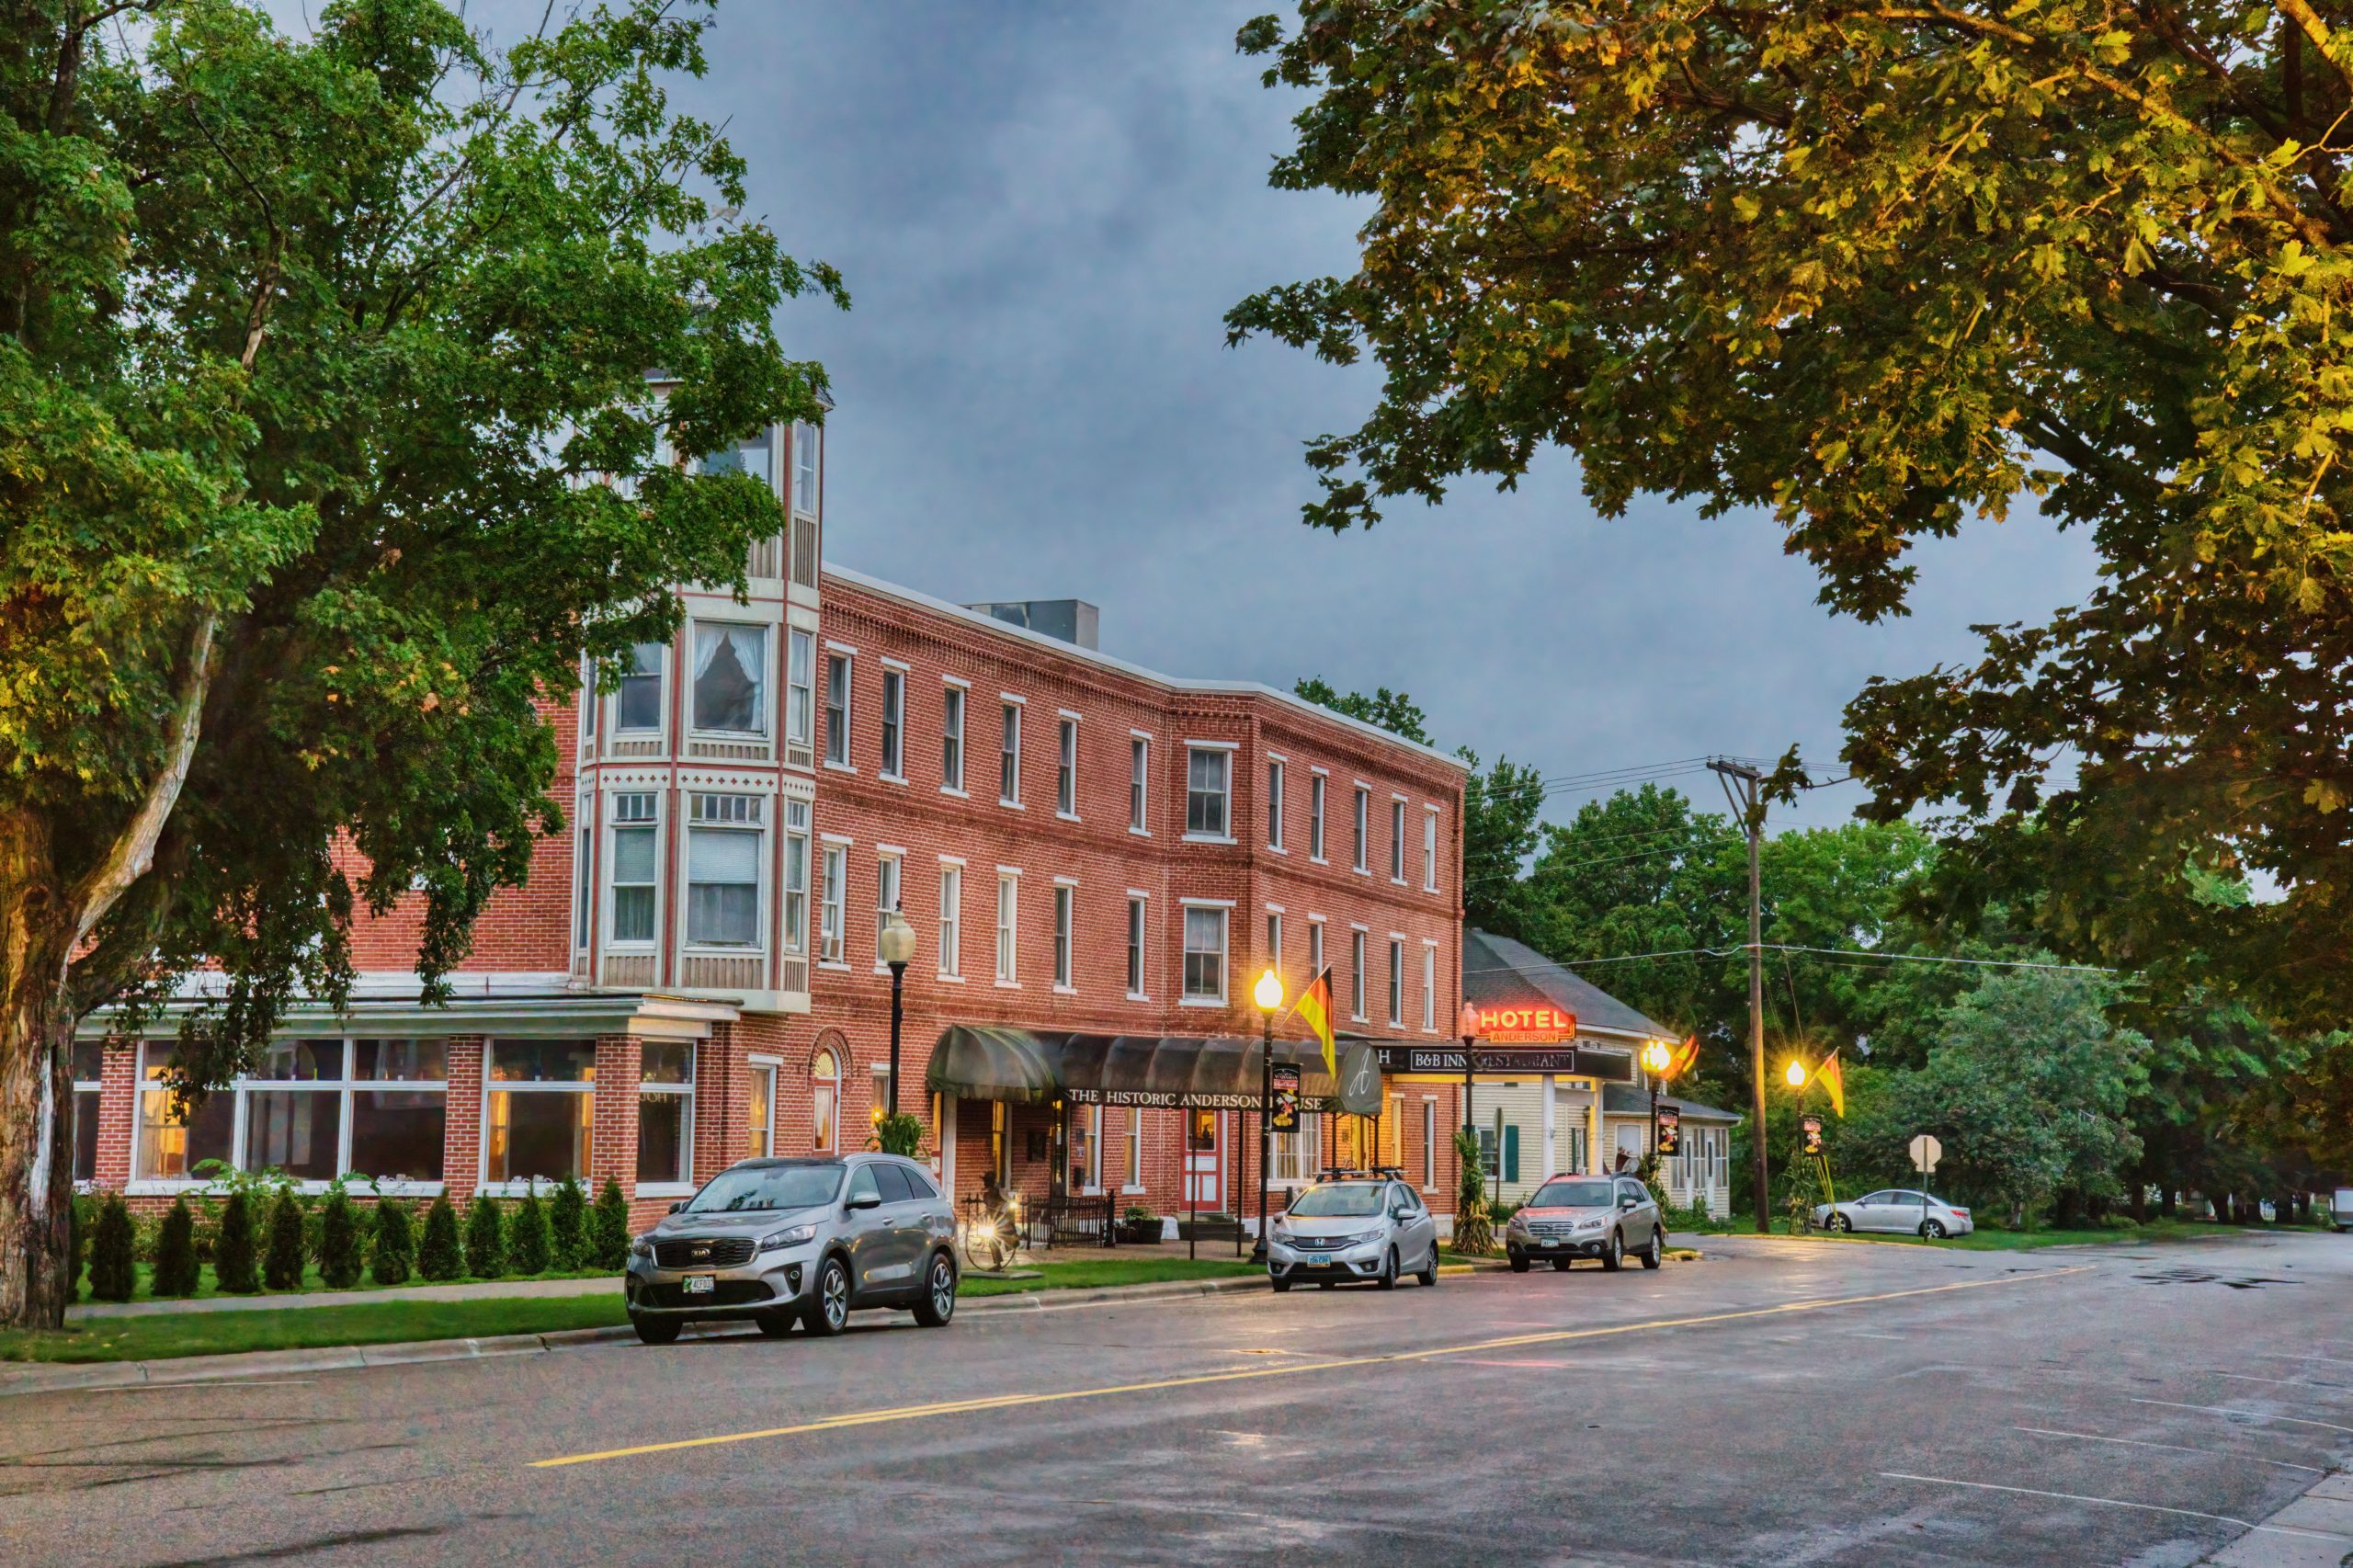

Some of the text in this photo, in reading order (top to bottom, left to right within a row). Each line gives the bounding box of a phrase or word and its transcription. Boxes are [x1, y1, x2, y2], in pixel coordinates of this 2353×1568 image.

[1481, 1010, 1566, 1028] HOTEL
[1493, 1032, 1556, 1041] ANDERSON
[1415, 1053, 1440, 1067] B&B
[1444, 1054, 1467, 1067] INN
[1069, 1088, 1099, 1102] THE
[1107, 1091, 1176, 1106] HISTORIC
[1180, 1094, 1262, 1108] ANDERSON
